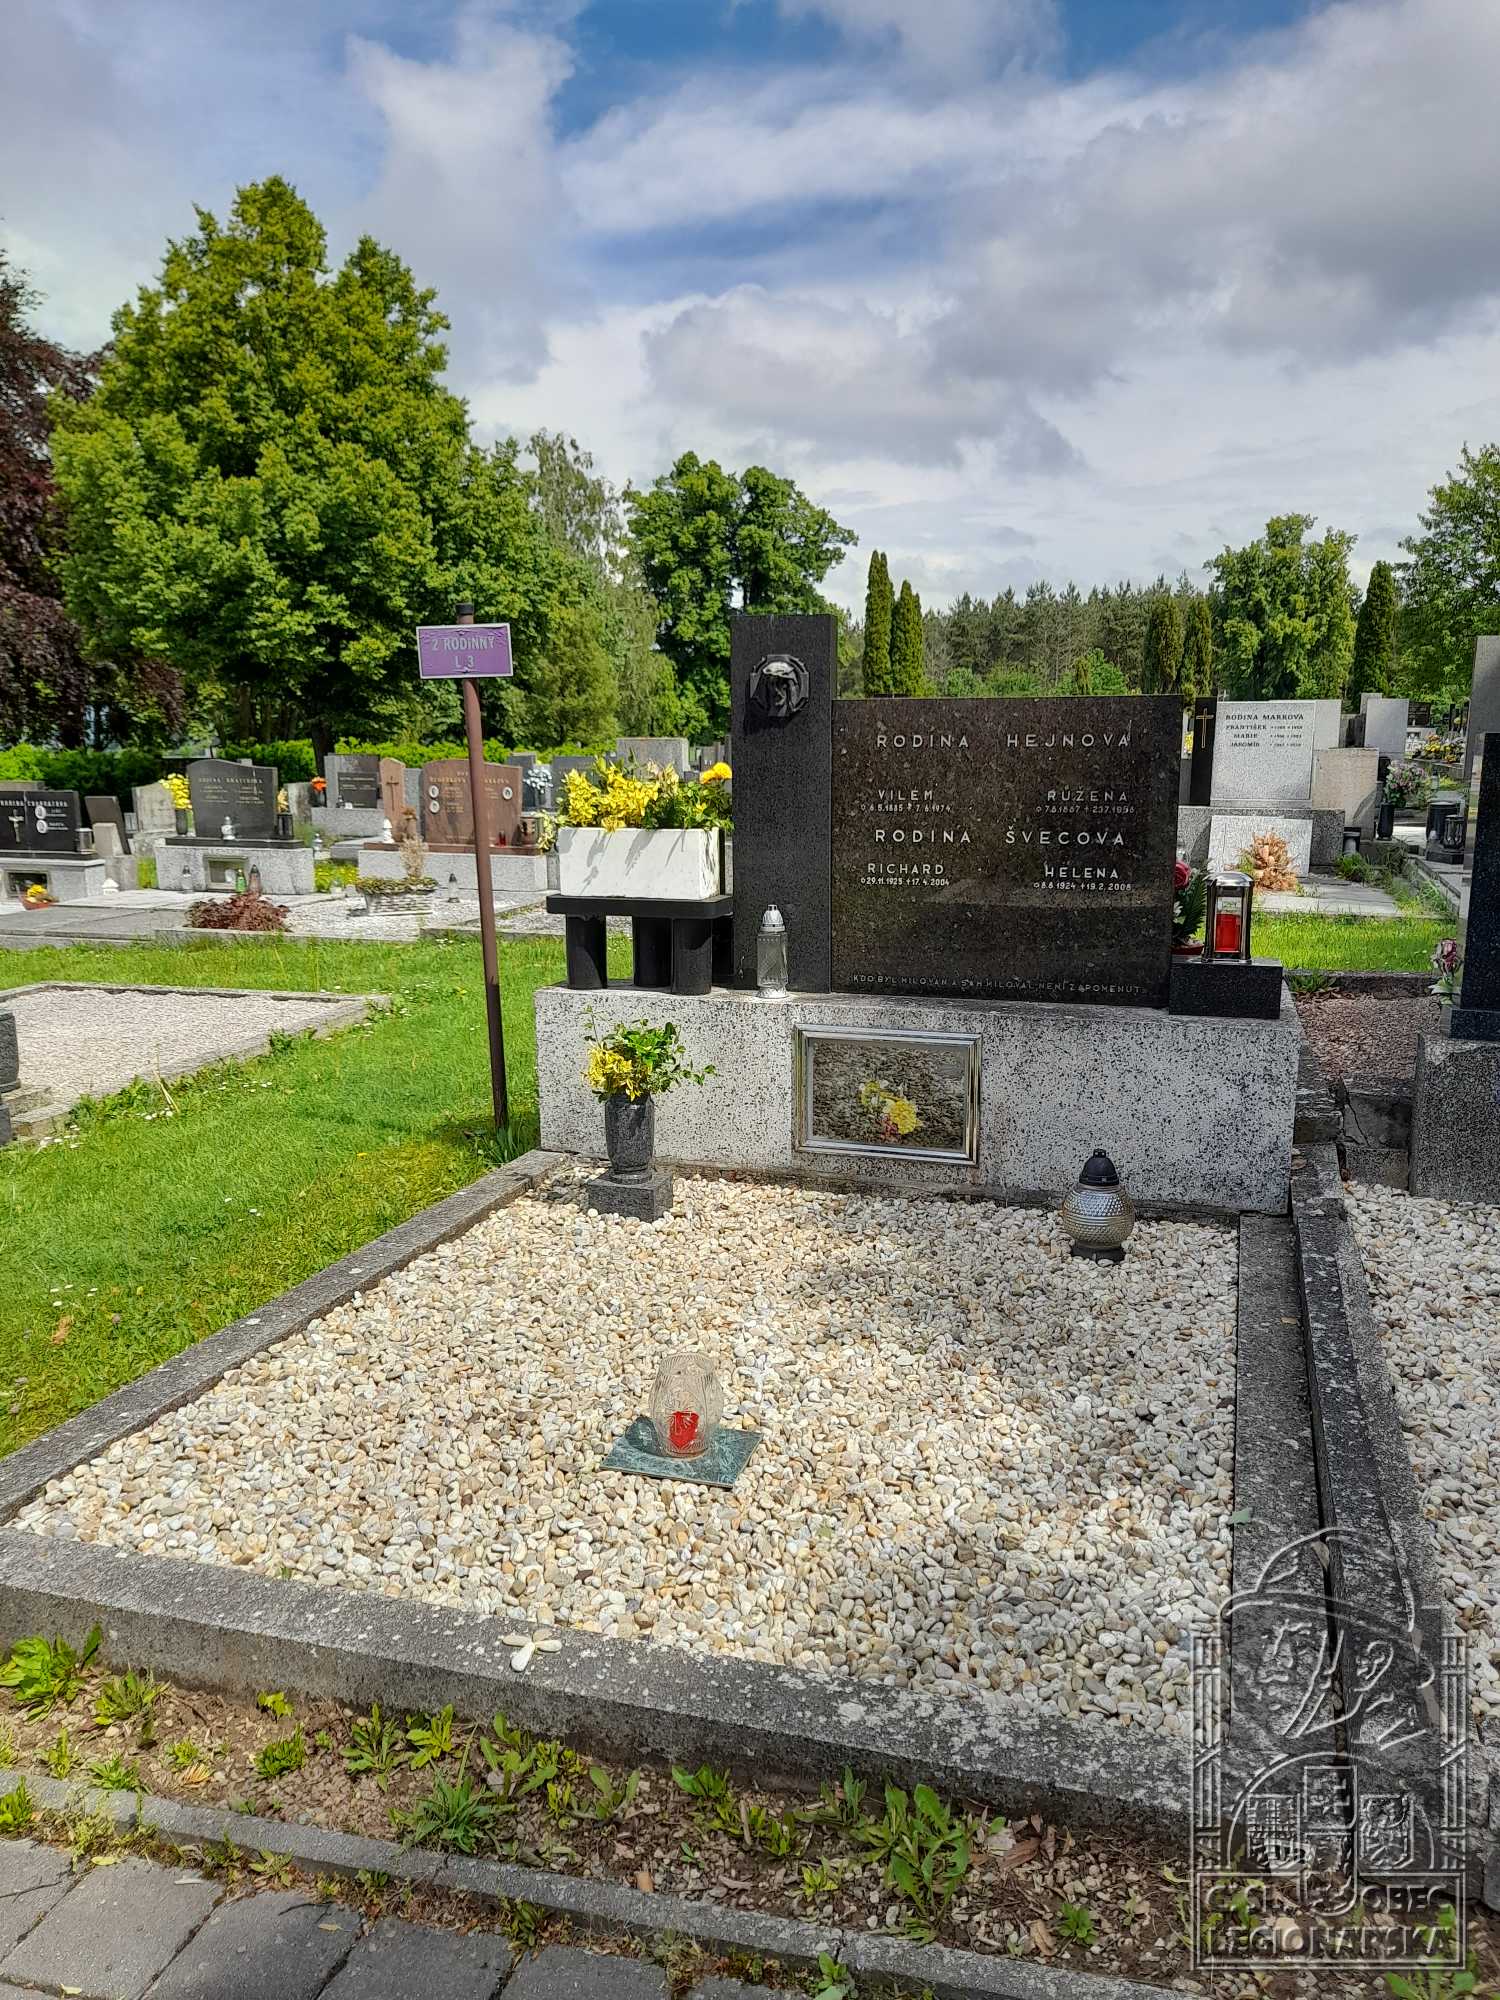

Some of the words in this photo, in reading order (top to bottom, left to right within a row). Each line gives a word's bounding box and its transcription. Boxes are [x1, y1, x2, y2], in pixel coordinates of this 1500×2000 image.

[877, 734, 969, 748] RODINA
[1007, 734, 1129, 748] HEJNOVA
[875, 829, 971, 843] RODINA
[1005, 825, 1124, 846] ŠVECOVA
[867, 863, 944, 875] RICHARD
[1044, 866, 1119, 879] HELENA
[853, 974, 874, 983] KDO
[877, 975, 897, 984] BYL
